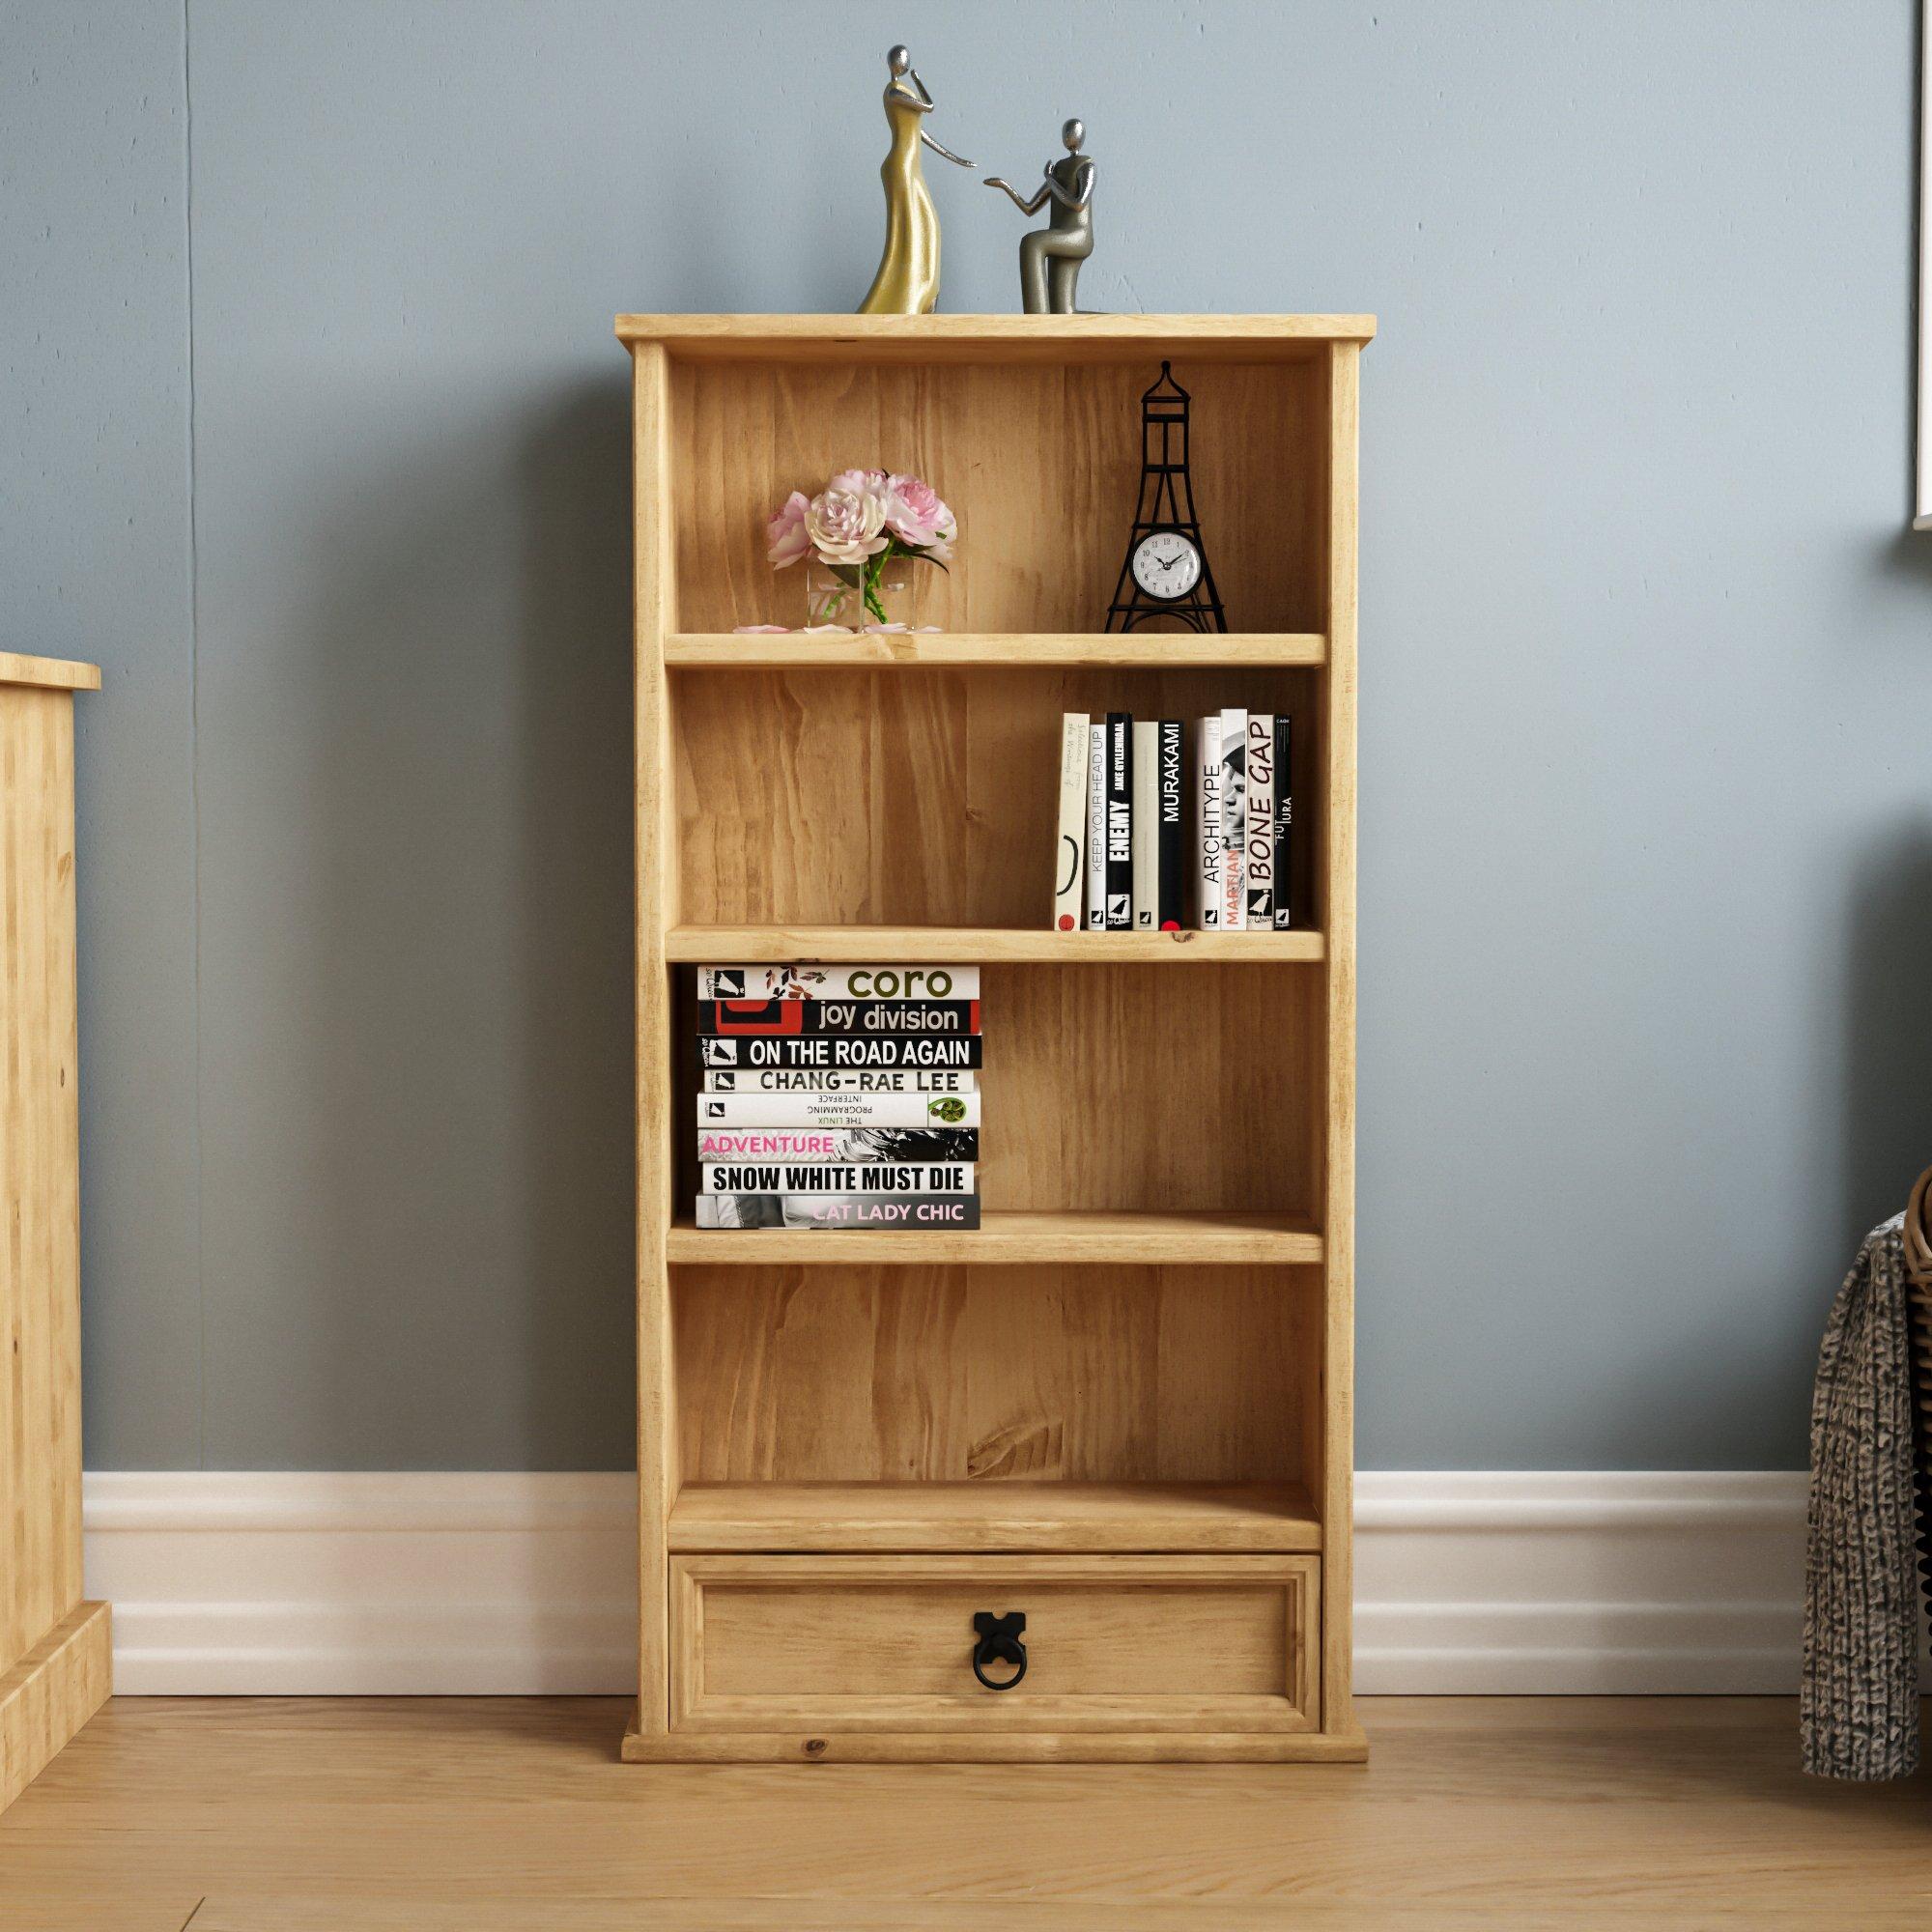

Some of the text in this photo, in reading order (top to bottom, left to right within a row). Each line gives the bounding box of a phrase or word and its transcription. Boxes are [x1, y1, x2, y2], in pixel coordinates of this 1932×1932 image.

[1142, 549, 1151, 557] 10
[1163, 537, 1171, 546] 12
[1152, 582, 1157, 591] 7
[1114, 772, 1124, 791] JAKE
[1163, 724, 1179, 822] MURAKAMI
[1092, 731, 1103, 873] KEEP YOUR HEAD UP
[1248, 721, 1273, 880] BONE GAP
[1204, 764, 1220, 884] ARCHITYPE
[1274, 796, 1293, 840] FUTURA
[1109, 800, 1130, 862] ENEMY
[1226, 849, 1239, 925] MARTIAN
[847, 970, 952, 998] coro
[818, 1000, 959, 1030] joy division
[750, 1039, 970, 1065] ON THE ROAD AGAIN
[760, 1070, 959, 1091] CHANG-RAE LEE
[807, 1105, 873, 1114] PROGRAMMING
[817, 1094, 863, 1103] INTERFACE
[818, 1117, 863, 1125] THE LINUX
[702, 1136, 835, 1153] ADVENTURE
[713, 1167, 964, 1191] SNOW WHITE MUST DIE
[812, 1204, 964, 1221] CAT LADY CHIC
